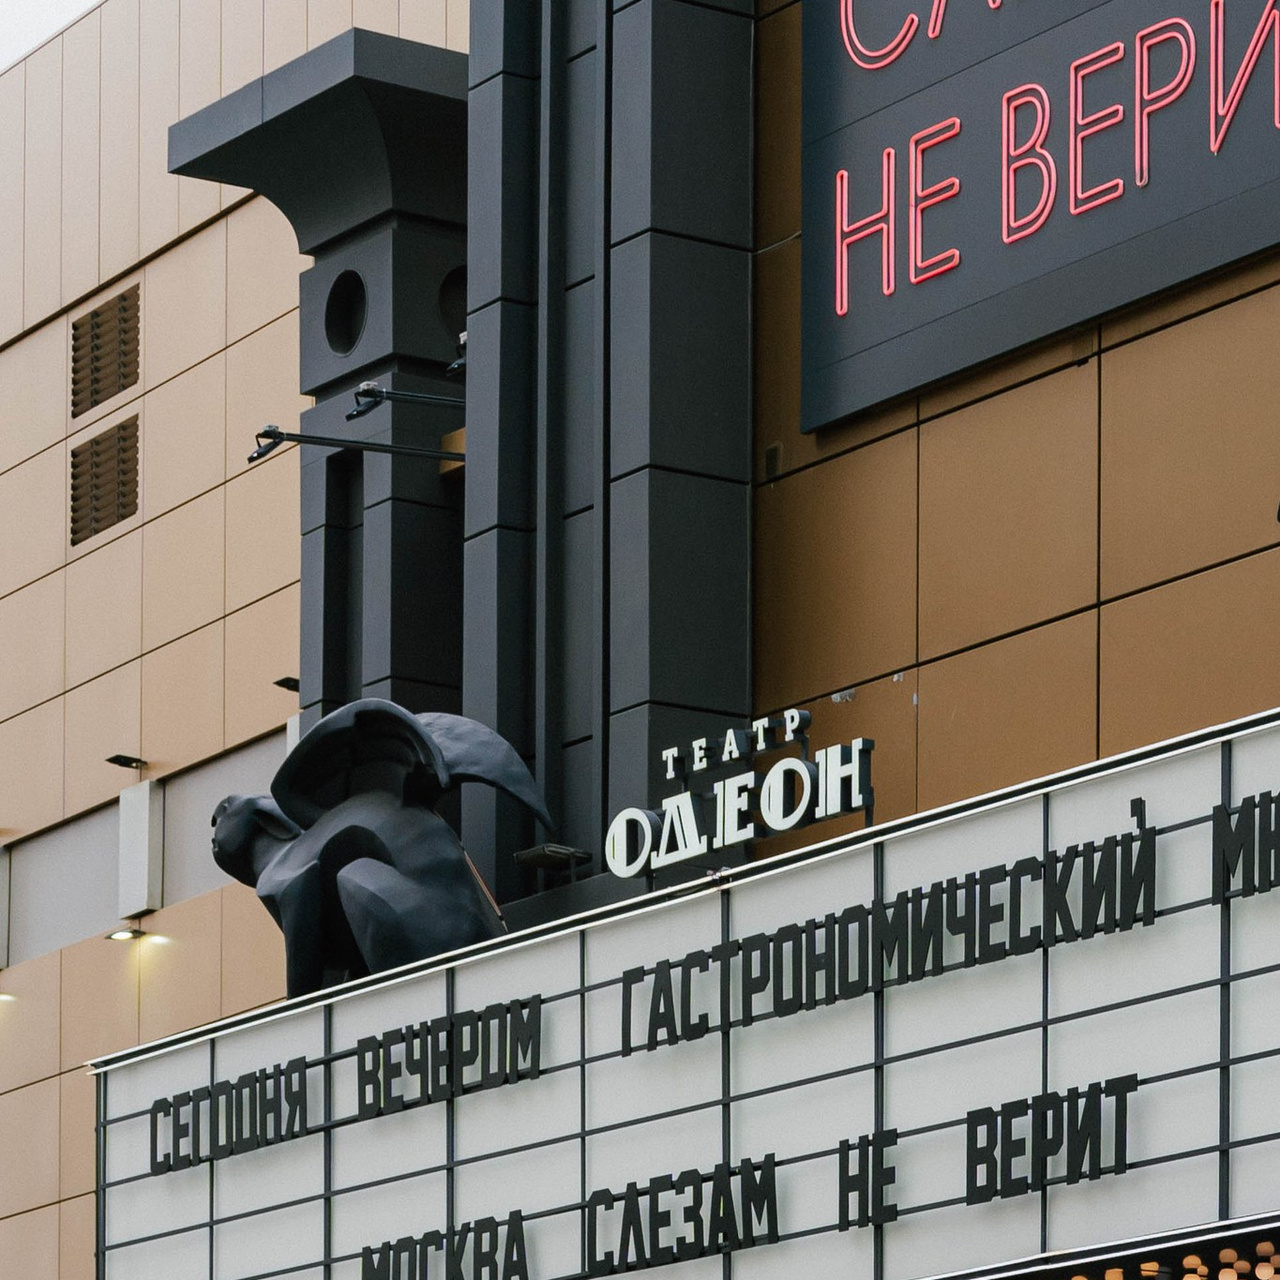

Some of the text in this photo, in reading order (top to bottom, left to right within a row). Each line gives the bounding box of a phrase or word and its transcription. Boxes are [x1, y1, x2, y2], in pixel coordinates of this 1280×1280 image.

[836, 116, 960, 316] НЕ
[605, 737, 863, 878] ОДЕОН
[662, 708, 800, 780] ТЕАТР
[150, 1056, 307, 1176] СЕГОДНЯ
[357, 994, 541, 1120] ВЕЧЕРОМ
[622, 797, 1156, 1057] ГАСТРОНОМИЧЕСКИЙ
[586, 1153, 778, 1276] СЛЕЗАМ
[838, 1128, 897, 1232] НЕ
[966, 1072, 1138, 1206] ВЕРИТ
